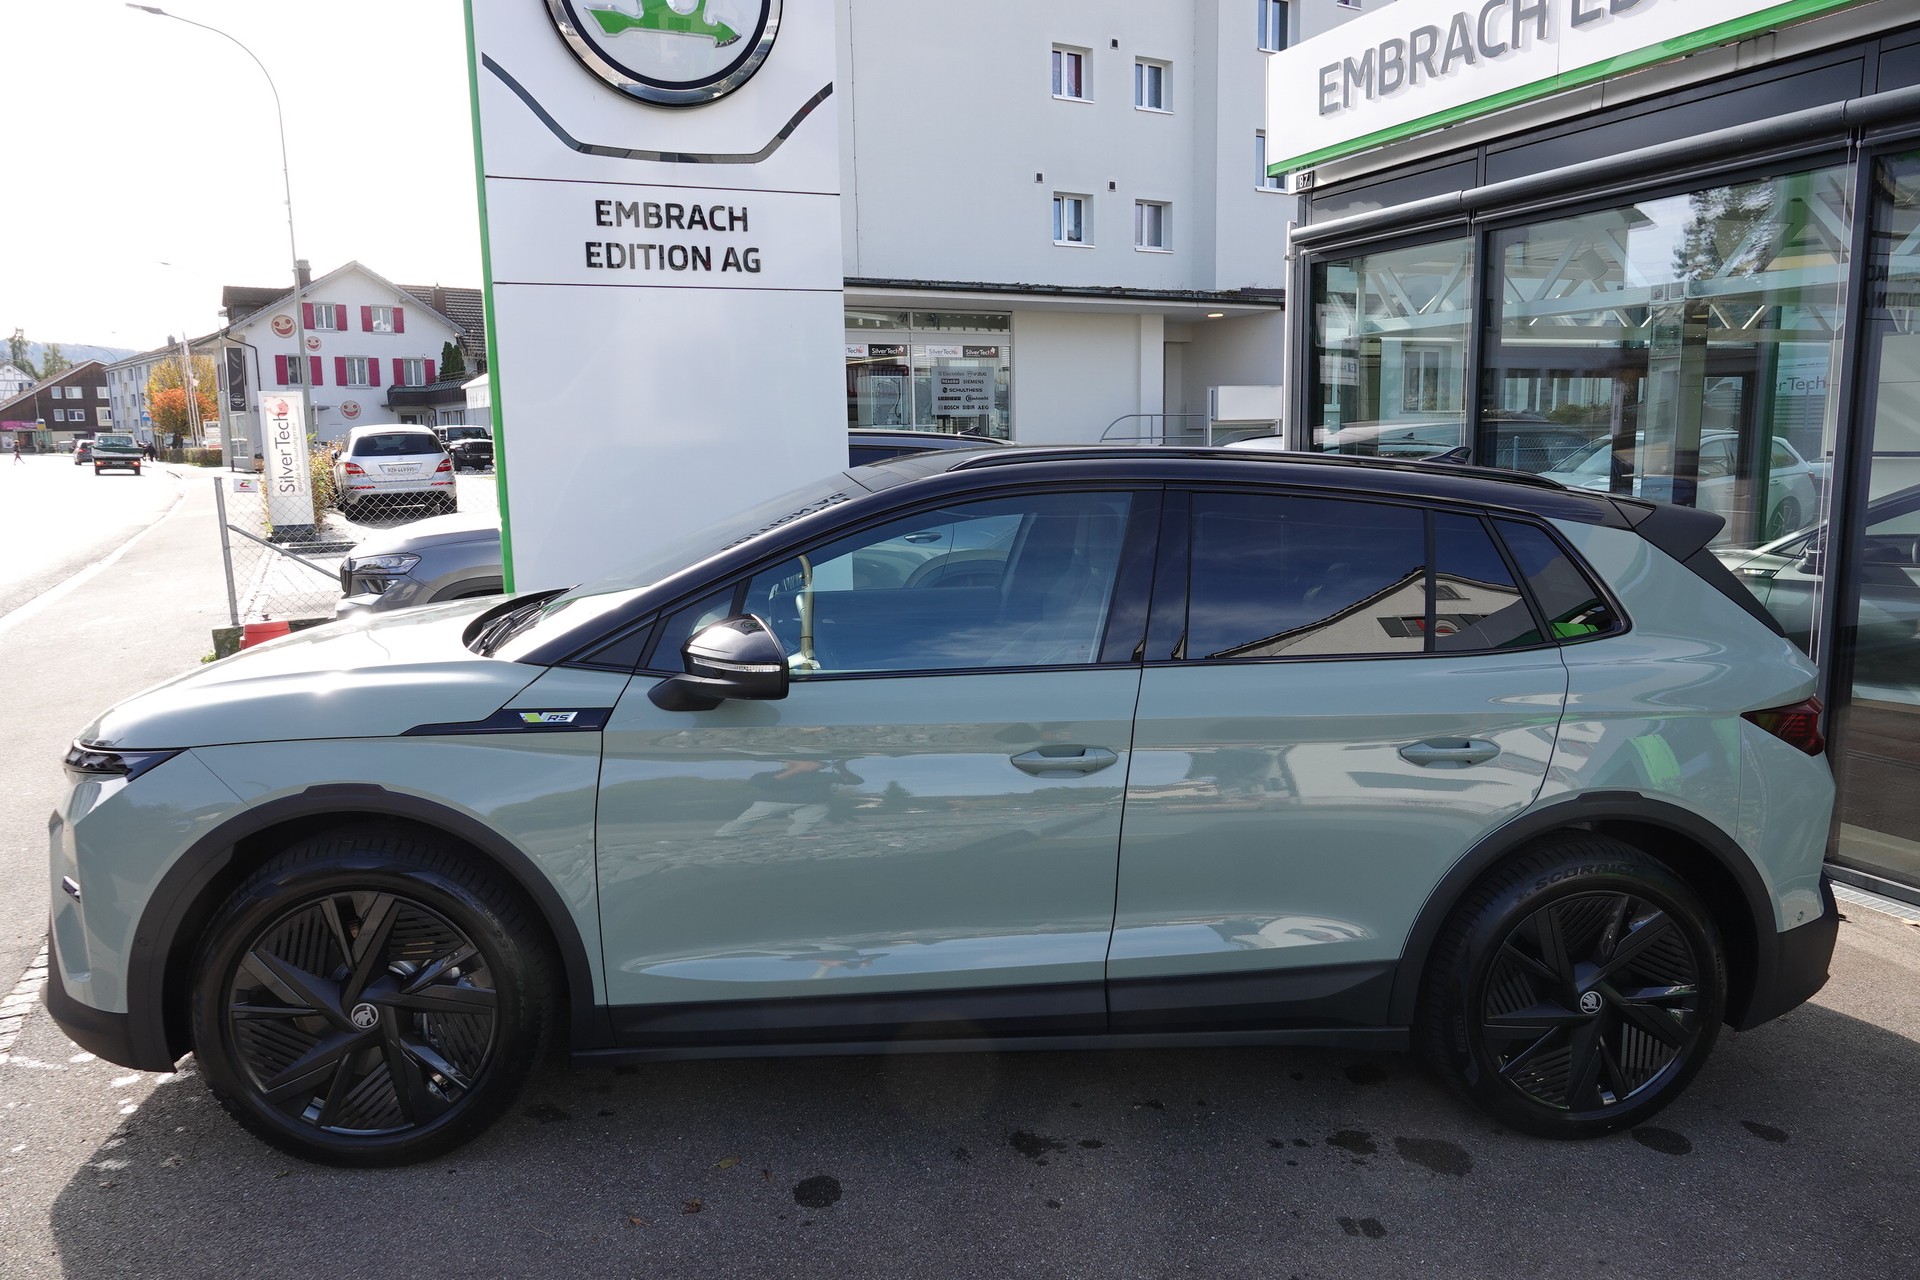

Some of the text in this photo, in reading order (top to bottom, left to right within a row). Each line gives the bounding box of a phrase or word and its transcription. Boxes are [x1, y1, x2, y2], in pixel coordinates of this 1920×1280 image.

[1319, 0, 1549, 116] EMBRACH
[1299, 174, 1309, 187] 87
[595, 200, 748, 232] EMBRACH
[585, 242, 761, 273] EDITION AG
